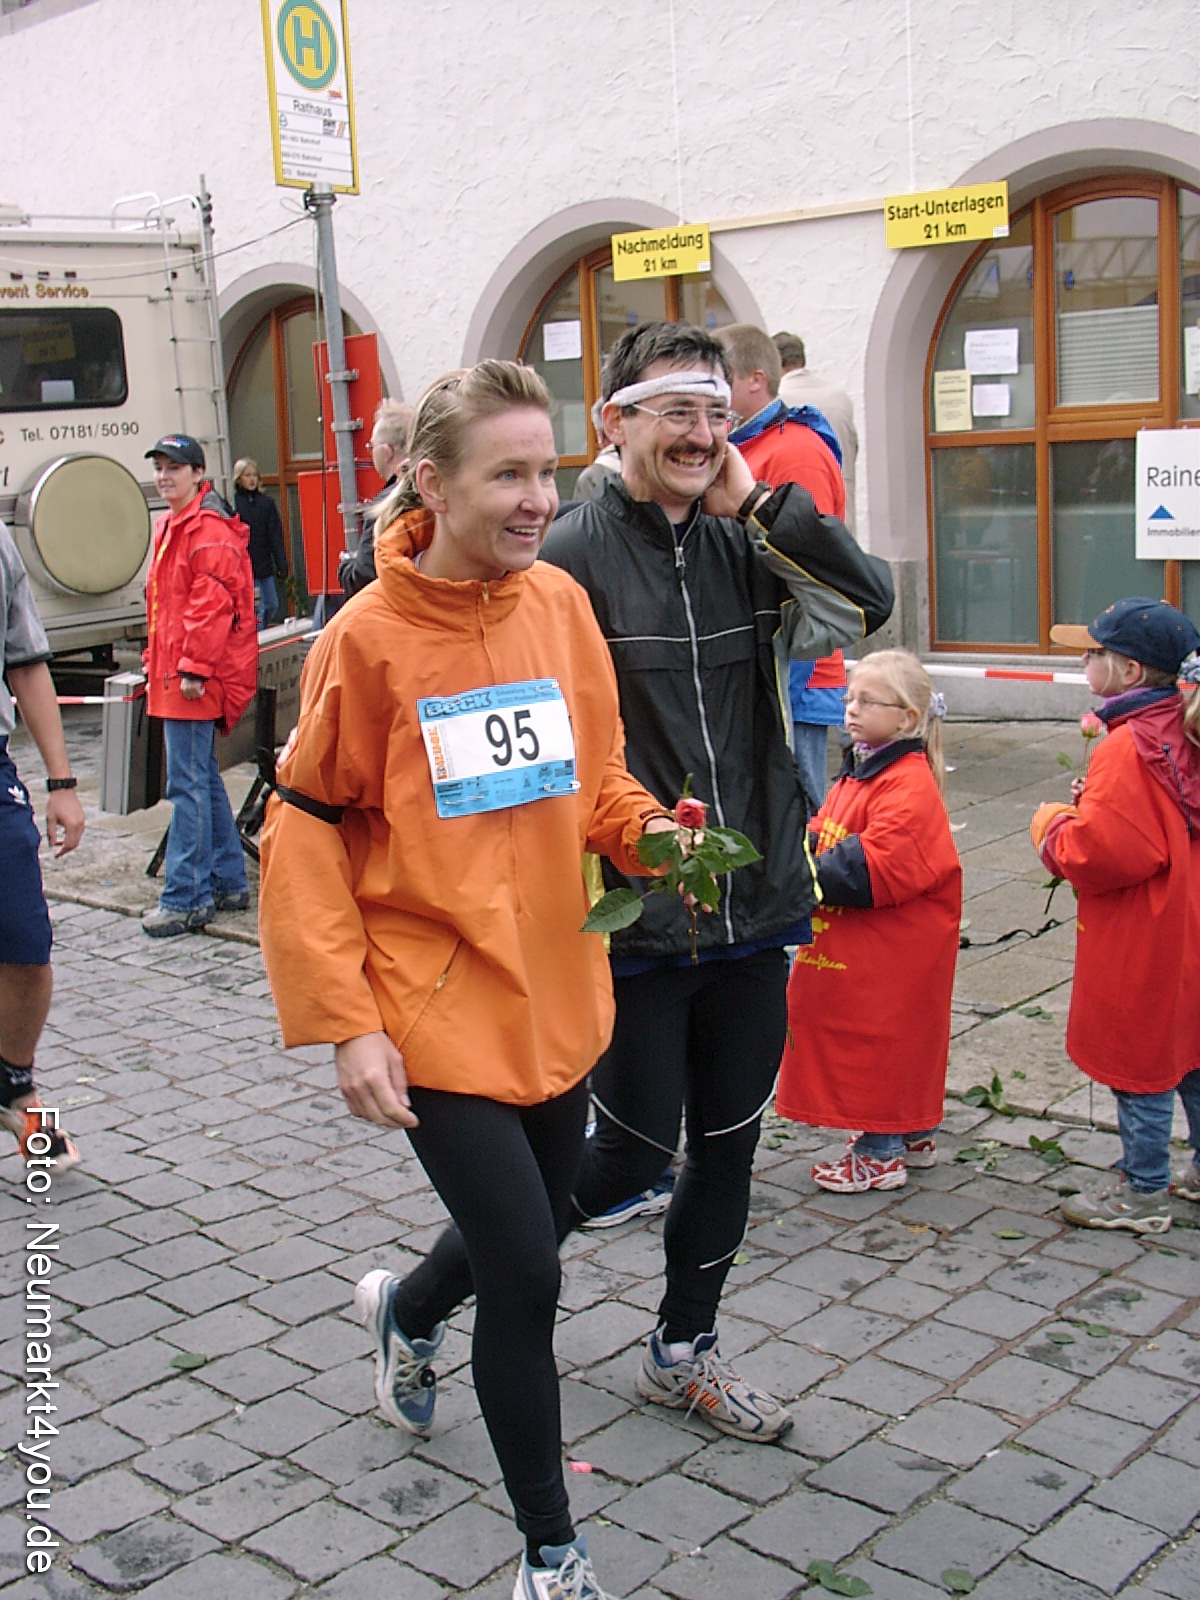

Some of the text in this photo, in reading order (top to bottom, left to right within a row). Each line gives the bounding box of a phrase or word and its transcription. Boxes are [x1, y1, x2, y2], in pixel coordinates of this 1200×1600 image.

[293, 15, 323, 70] H
[293, 99, 333, 117] Rathaus
[888, 195, 1004, 221] Start-Unterlagen
[923, 222, 967, 239] 21 km
[617, 233, 703, 256] Nachmeldung
[643, 257, 677, 273] 21 km
[35, 283, 89, 298] Service
[21, 428, 45, 442] Tel.
[49, 421, 140, 441] 07181/5090
[485, 709, 540, 767] 95
